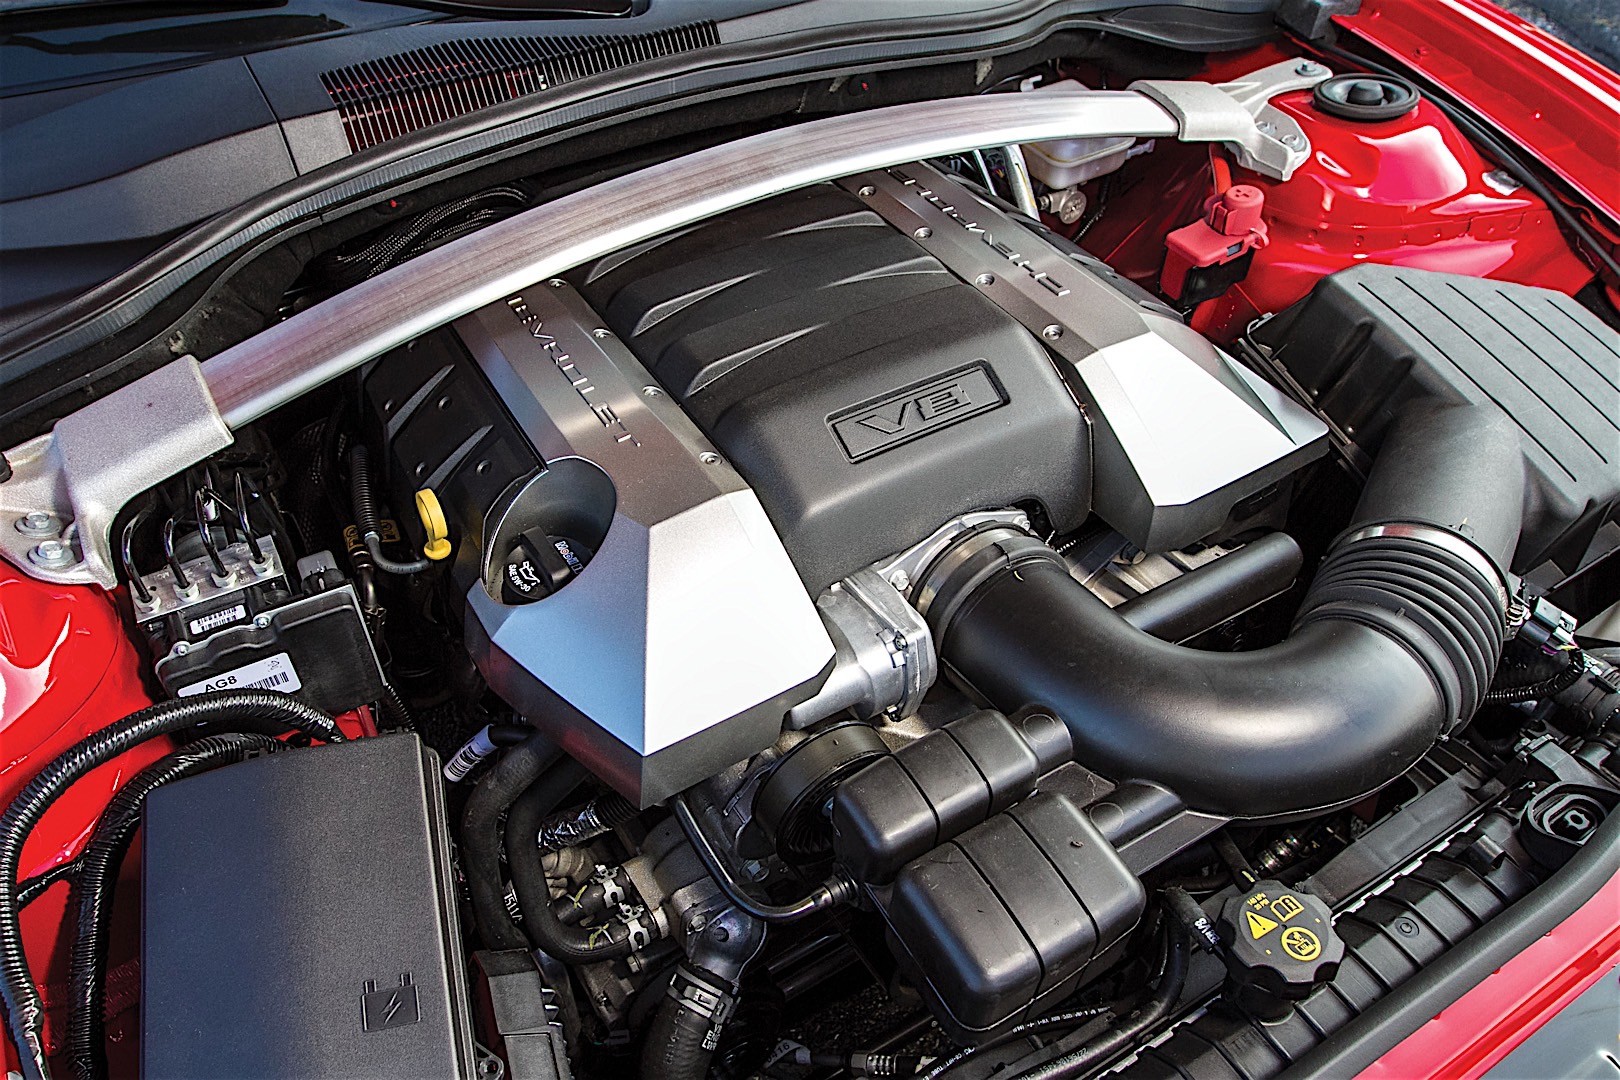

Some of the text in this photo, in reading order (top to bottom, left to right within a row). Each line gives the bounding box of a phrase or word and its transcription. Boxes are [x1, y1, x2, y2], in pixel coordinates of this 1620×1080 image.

[884, 168, 1071, 296] CHEVROLE
[855, 383, 972, 435] V8
[554, 540, 580, 568] Mobil
[508, 563, 532, 592] SAE 5W-30
[204, 675, 238, 693] AG8
